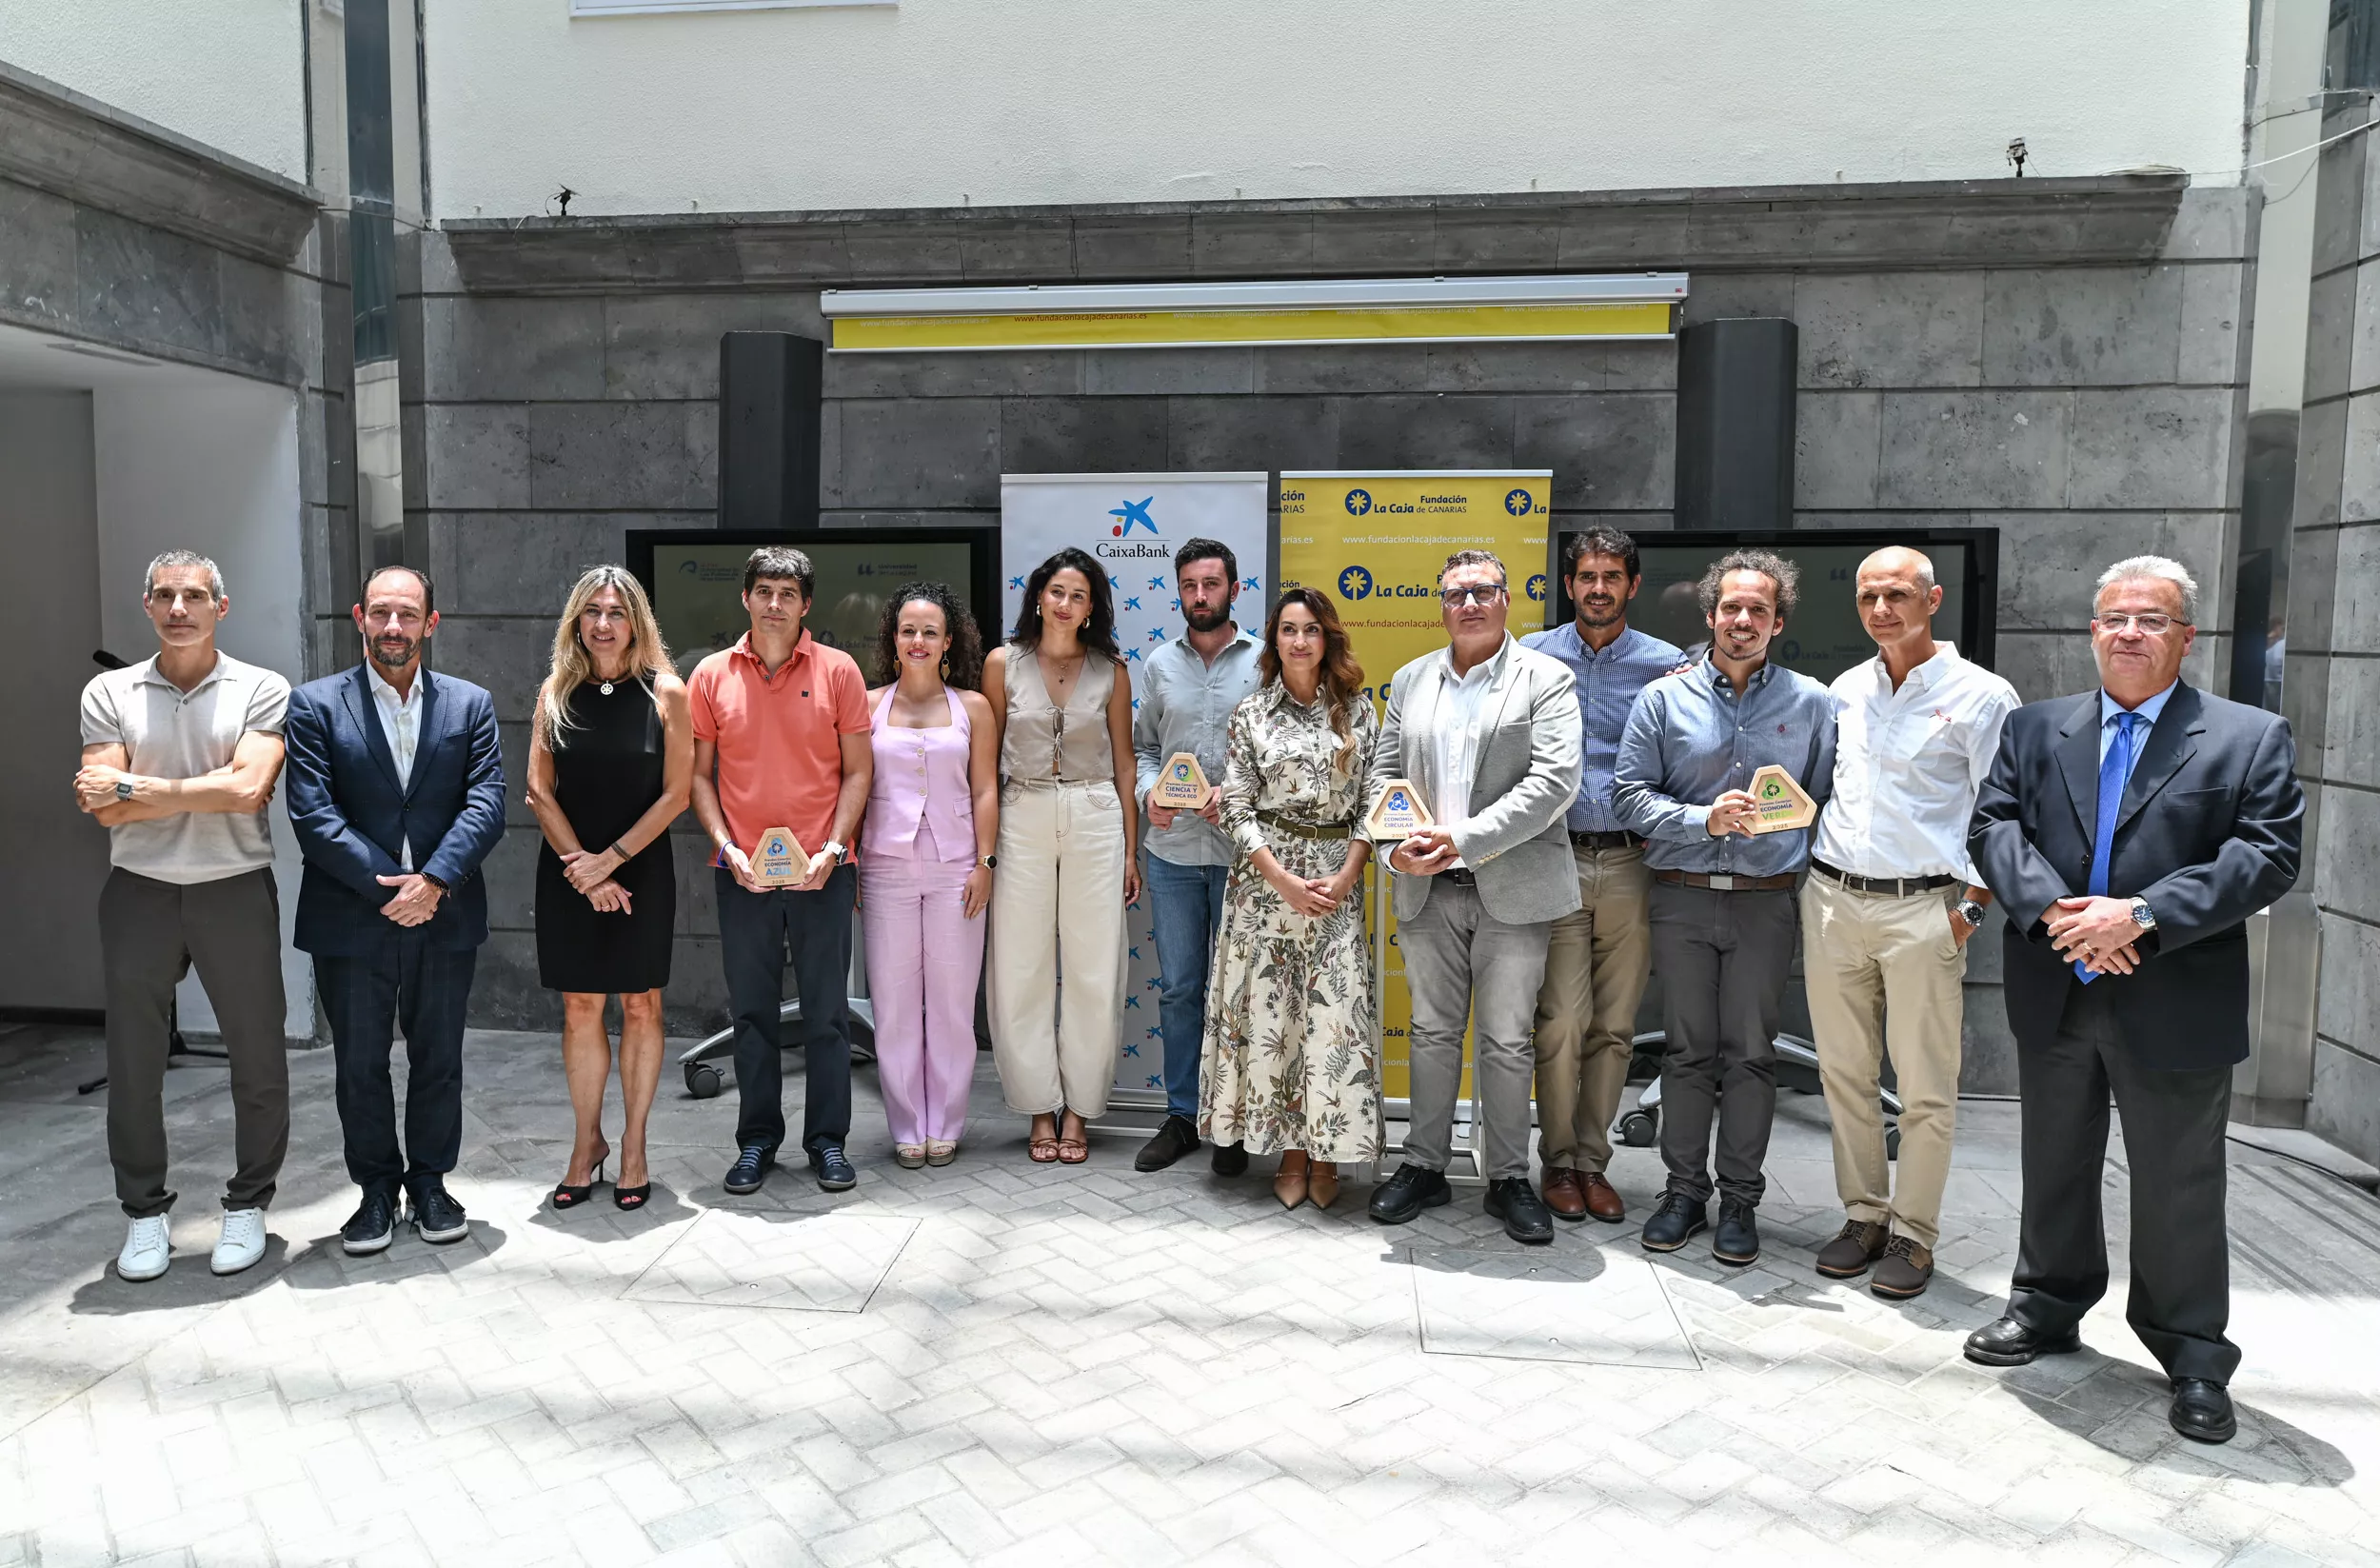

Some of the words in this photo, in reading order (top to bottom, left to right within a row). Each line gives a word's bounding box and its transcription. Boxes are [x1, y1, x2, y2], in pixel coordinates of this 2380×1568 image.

[860, 317, 990, 328] www.fundacionlacajadecanarias.es
[1014, 312, 1148, 324] www.fundacionlacajadecanarias.es
[1420, 495, 1467, 504] Fundación
[1374, 504, 1387, 513] La
[1389, 503, 1414, 515] Caja
[1534, 505, 1547, 514] La
[1342, 534, 1496, 546] www.fundacionlacajadecanarias.es
[1096, 543, 1171, 558] CaixaBank
[1376, 585, 1392, 598] La
[1396, 585, 1428, 601] Caja
[1760, 803, 1794, 812] ECONOMÍA
[765, 867, 792, 876] AZUL
